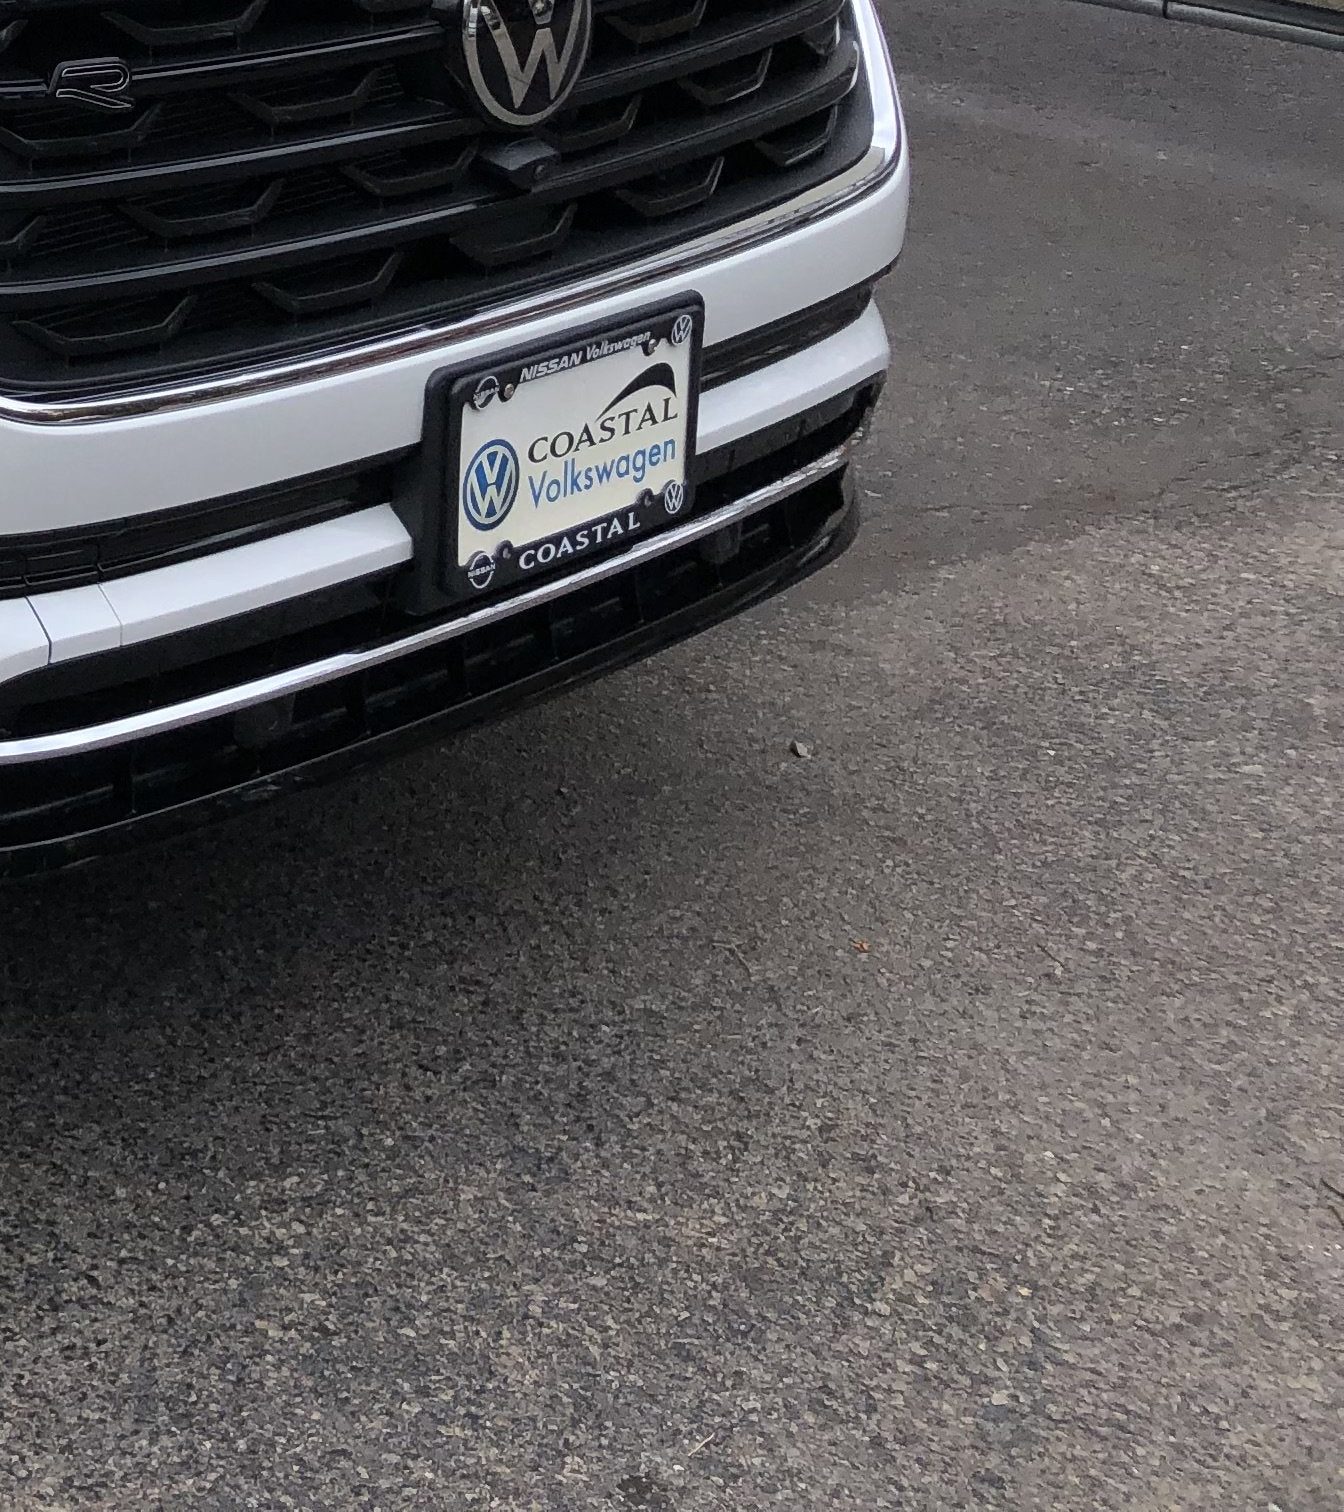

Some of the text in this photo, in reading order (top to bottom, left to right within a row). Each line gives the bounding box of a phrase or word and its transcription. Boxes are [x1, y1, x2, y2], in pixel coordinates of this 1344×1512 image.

[519, 331, 652, 384] NISSAN Volkswagen
[527, 396, 679, 464] COASTAL
[527, 438, 677, 509] Volkswagen
[518, 511, 642, 570] COASTAL
